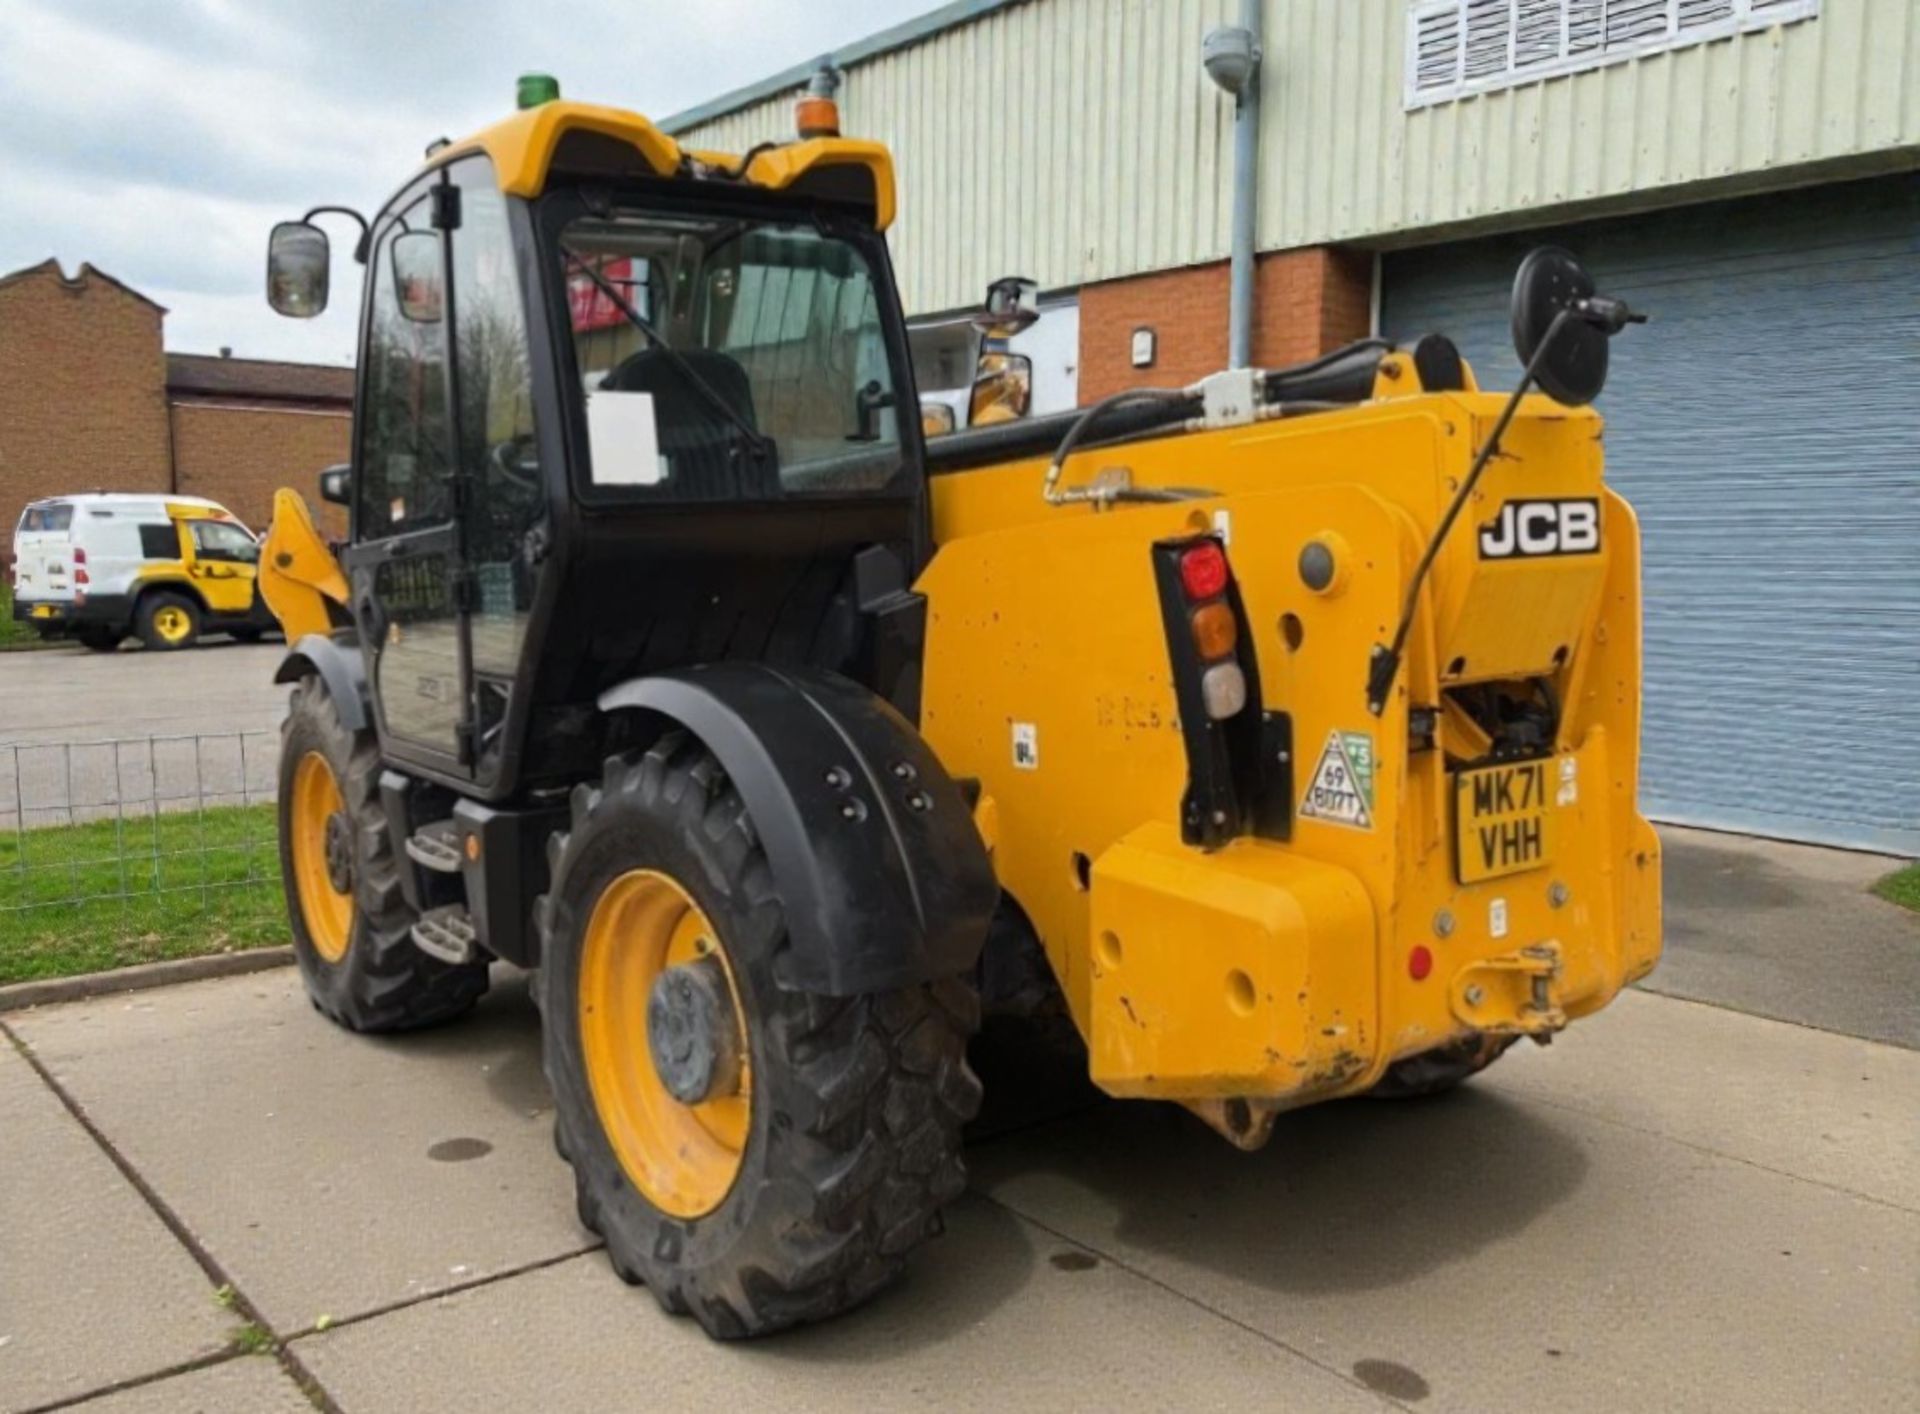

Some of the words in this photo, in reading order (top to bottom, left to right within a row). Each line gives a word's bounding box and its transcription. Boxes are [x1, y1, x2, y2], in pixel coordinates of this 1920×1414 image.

[1481, 502, 1598, 556] JCB
[1473, 762, 1544, 818] MK71
[1480, 814, 1541, 871] VHH
